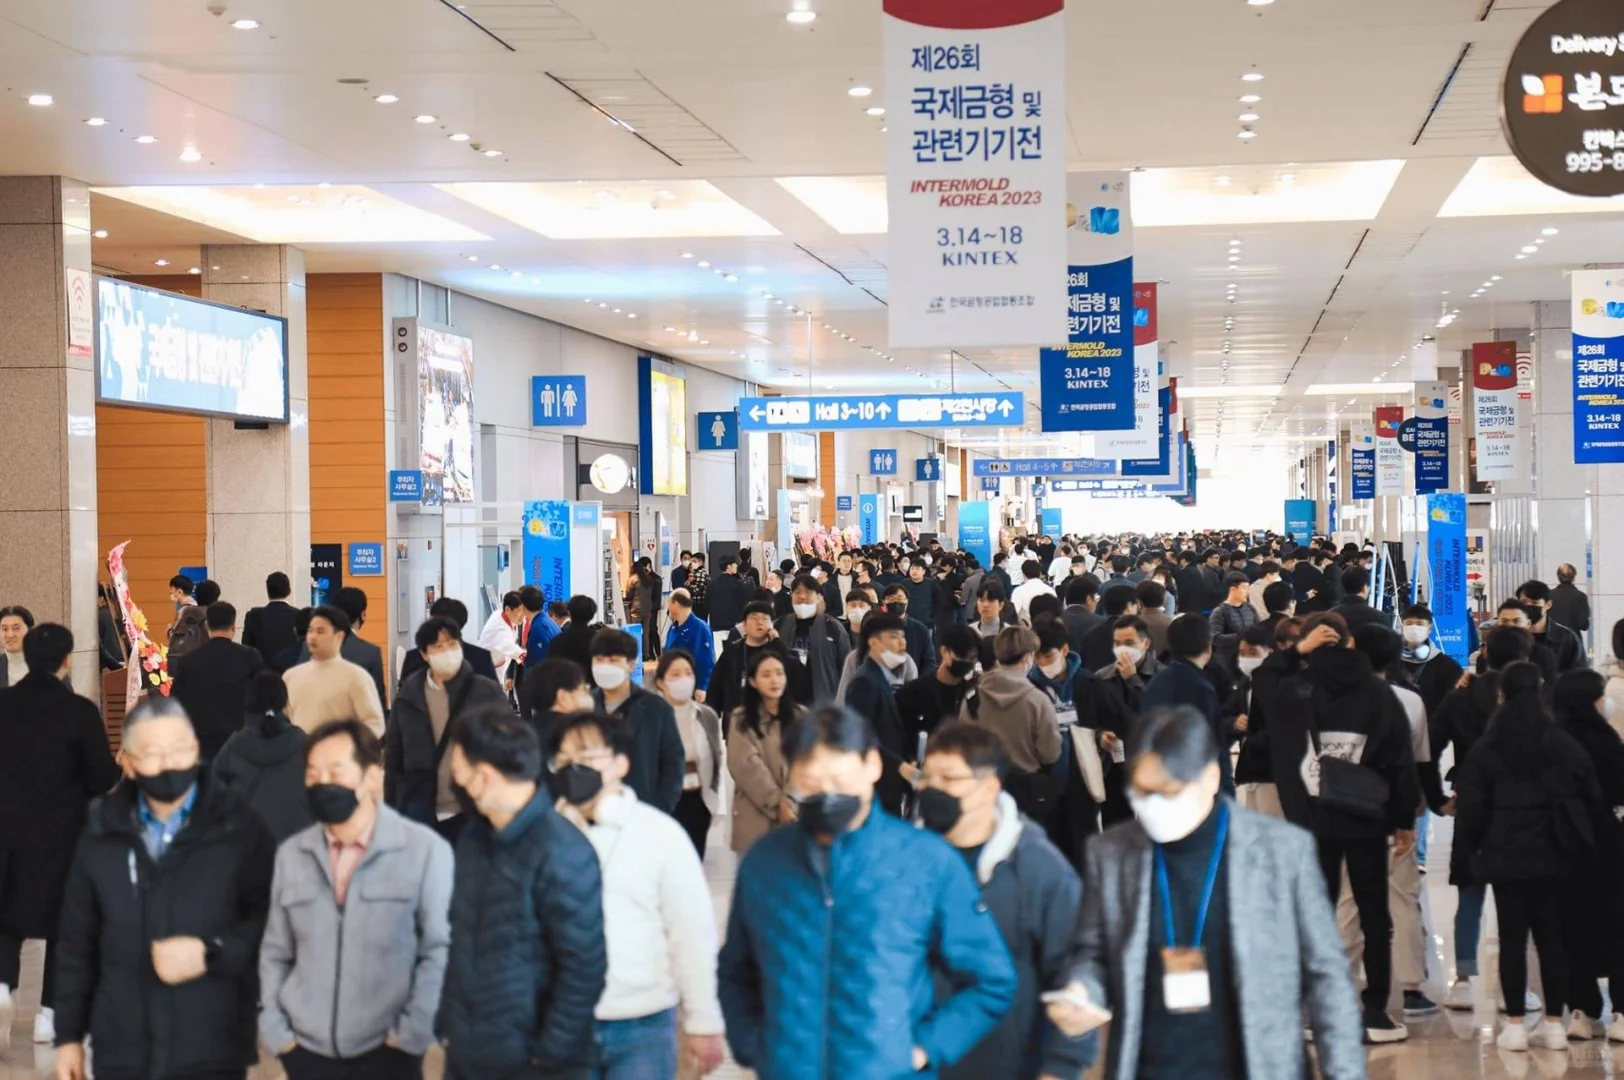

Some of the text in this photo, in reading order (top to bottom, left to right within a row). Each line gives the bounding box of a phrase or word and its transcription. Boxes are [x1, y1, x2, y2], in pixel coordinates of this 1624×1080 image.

[1551, 34, 1617, 56] Delivery
[911, 43, 981, 73] 제26회
[911, 83, 1042, 120] 국제금형 및
[912, 126, 1042, 163] 관련기기전
[1565, 151, 1624, 173] 995-8
[910, 177, 1009, 194] INTERMOLD
[939, 191, 1042, 208] KOREA 2023
[936, 226, 1023, 247] 3.14~18
[942, 250, 1018, 266] KINTEX
[1068, 292, 1120, 312] 제금형 및
[1068, 314, 1121, 334] 련기기전
[1067, 348, 1122, 358] KOREA 2023
[1577, 344, 1605, 356] 제26회
[1064, 366, 1111, 379] 3.14~18
[1577, 358, 1618, 373] 국제금형
[1067, 380, 1109, 389] KINTEX
[815, 403, 839, 420] Hall
[1588, 422, 1620, 430] KINTEX
[553, 557, 563, 602] INTERM
